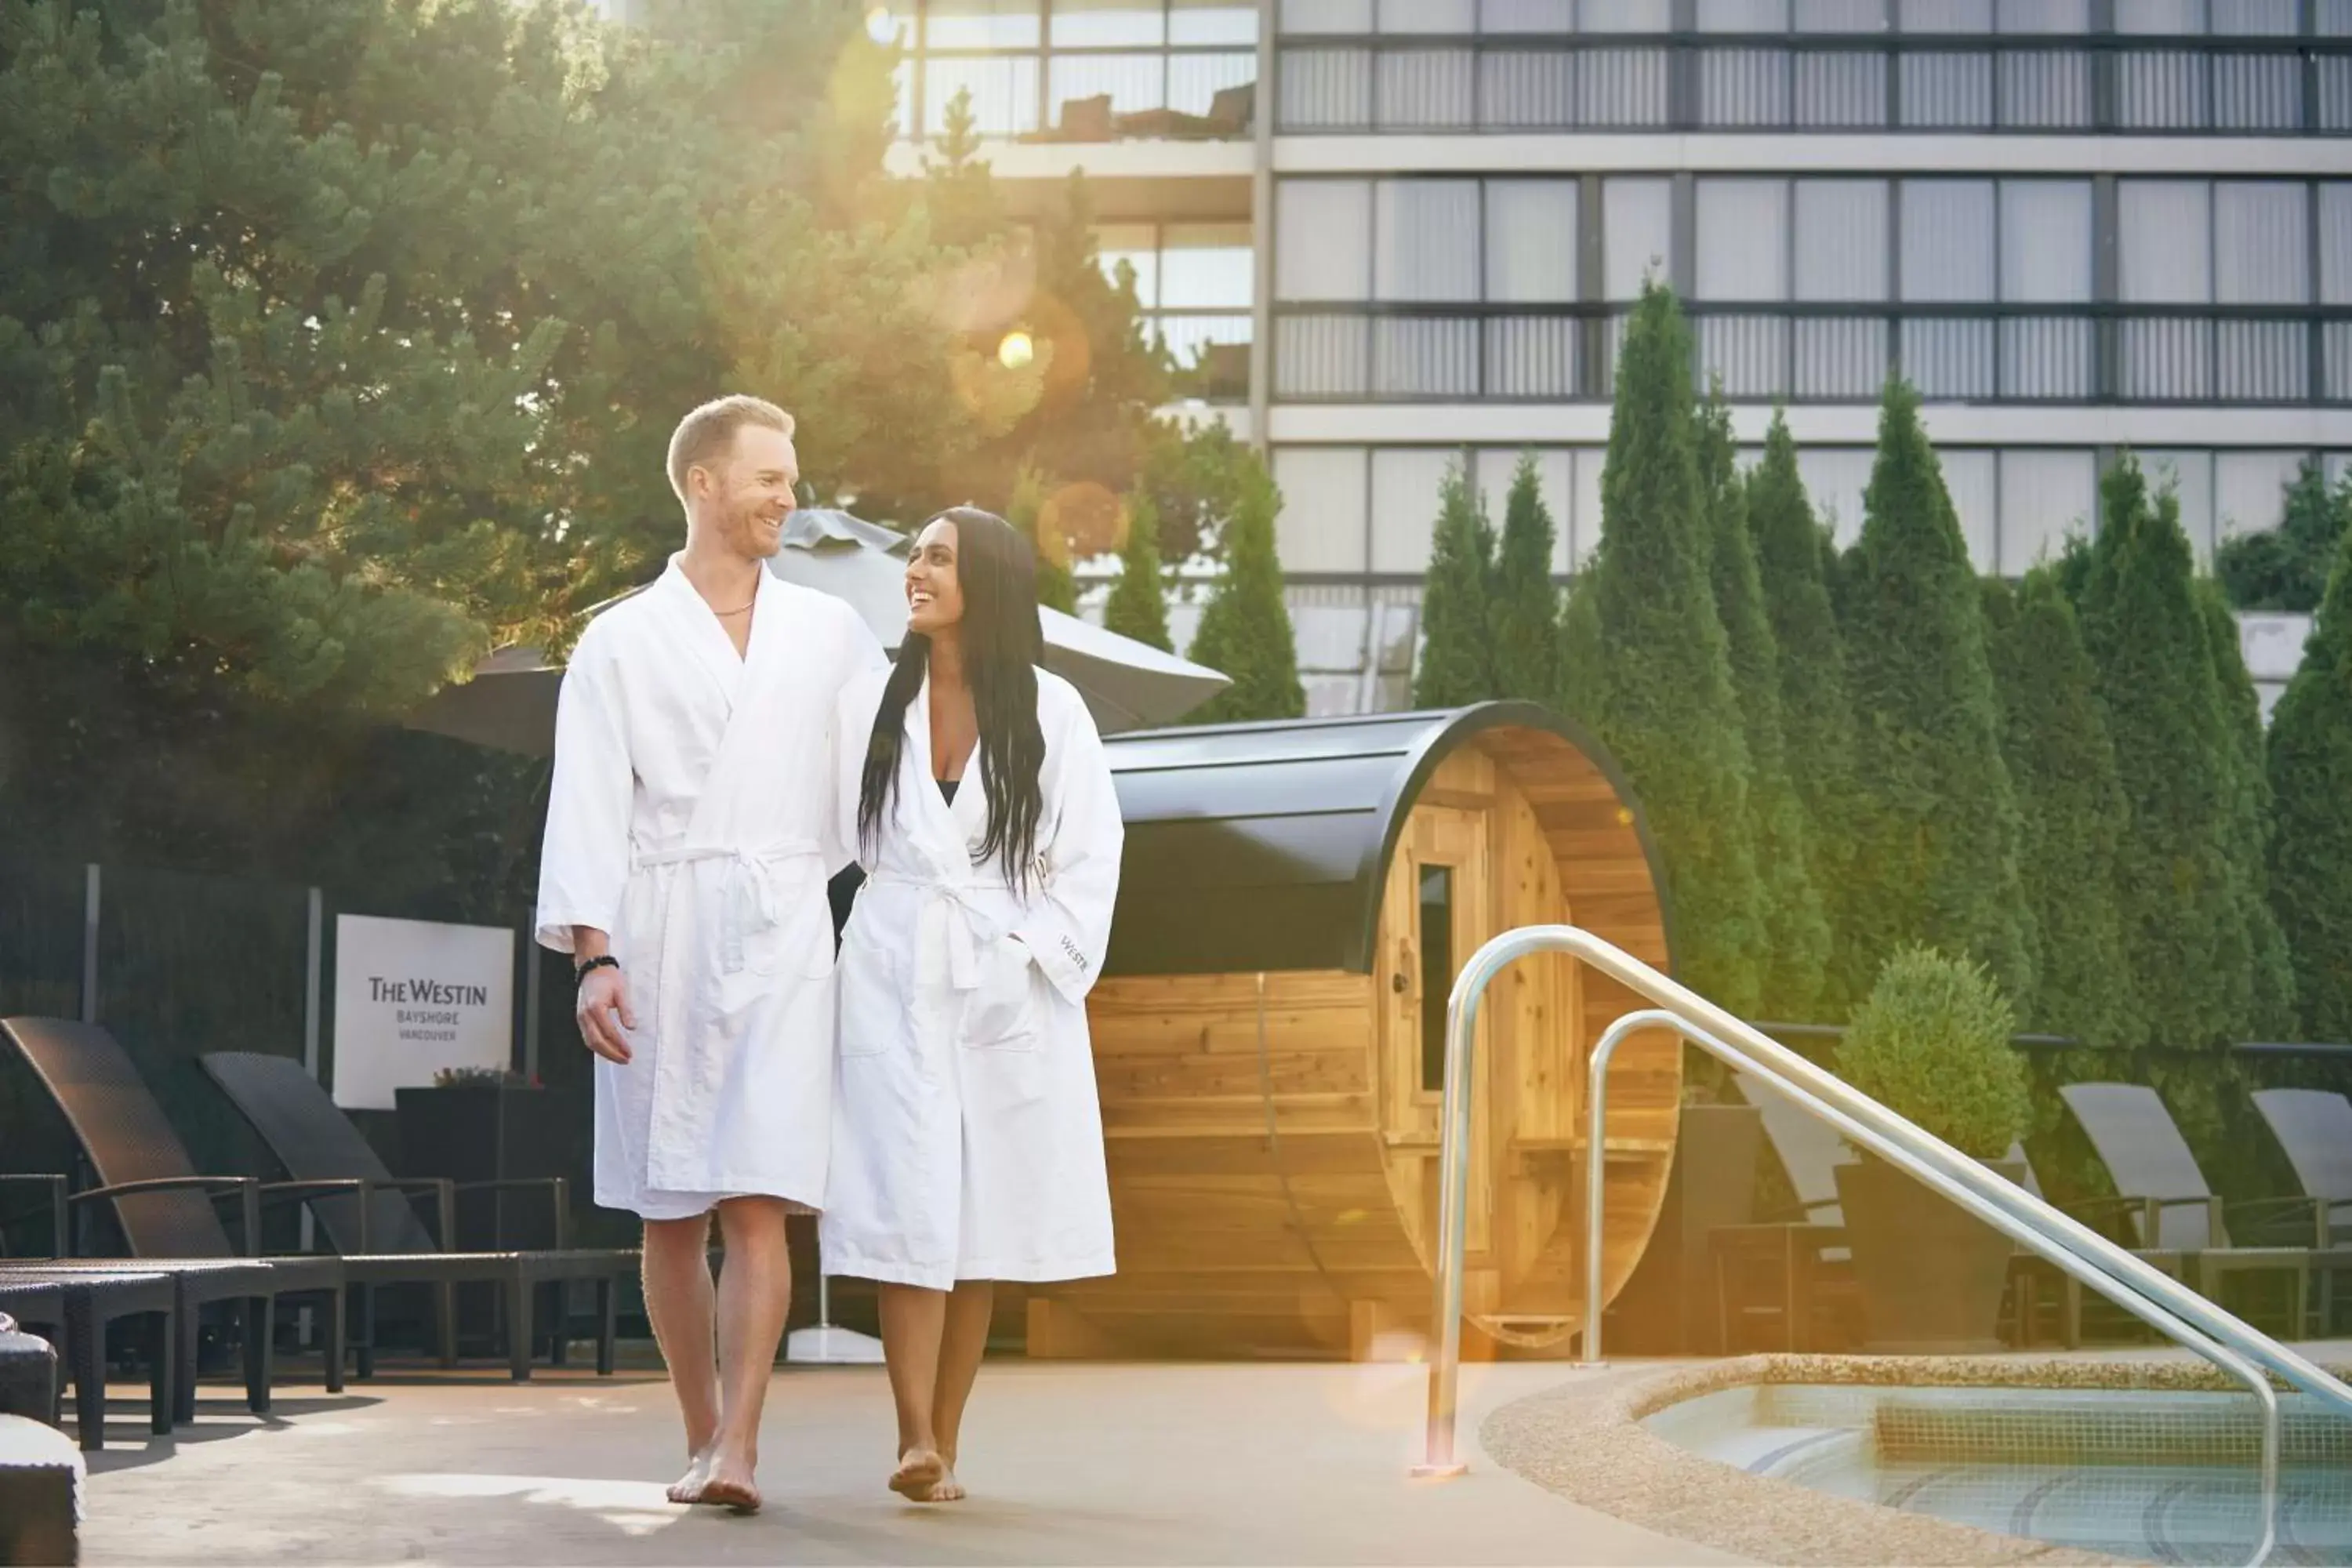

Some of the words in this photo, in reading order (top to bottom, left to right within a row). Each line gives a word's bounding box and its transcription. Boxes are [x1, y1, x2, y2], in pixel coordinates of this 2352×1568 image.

[369, 978, 407, 1003] THE
[409, 979, 486, 1006] WESTIN
[397, 1011, 459, 1025] BAYSHORE
[400, 1030, 456, 1042] VANCOUVER
